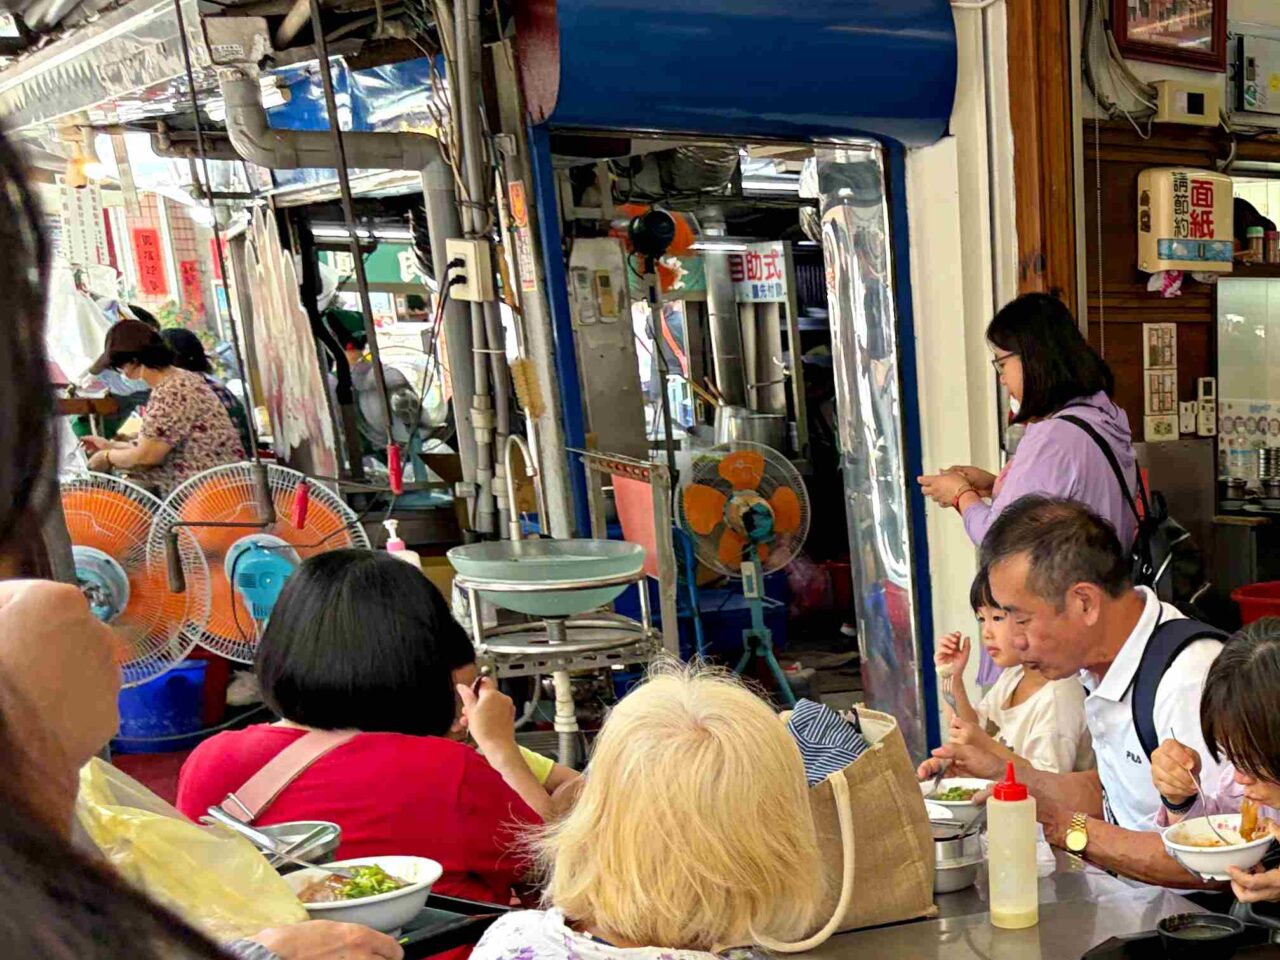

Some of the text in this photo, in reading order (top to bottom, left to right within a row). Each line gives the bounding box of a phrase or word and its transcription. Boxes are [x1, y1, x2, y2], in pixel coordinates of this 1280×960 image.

[1172, 172, 1189, 238] 請節約
[1190, 179, 1214, 239] 面紙
[728, 249, 782, 282] 自助式
[1126, 750, 1142, 764] FILA
